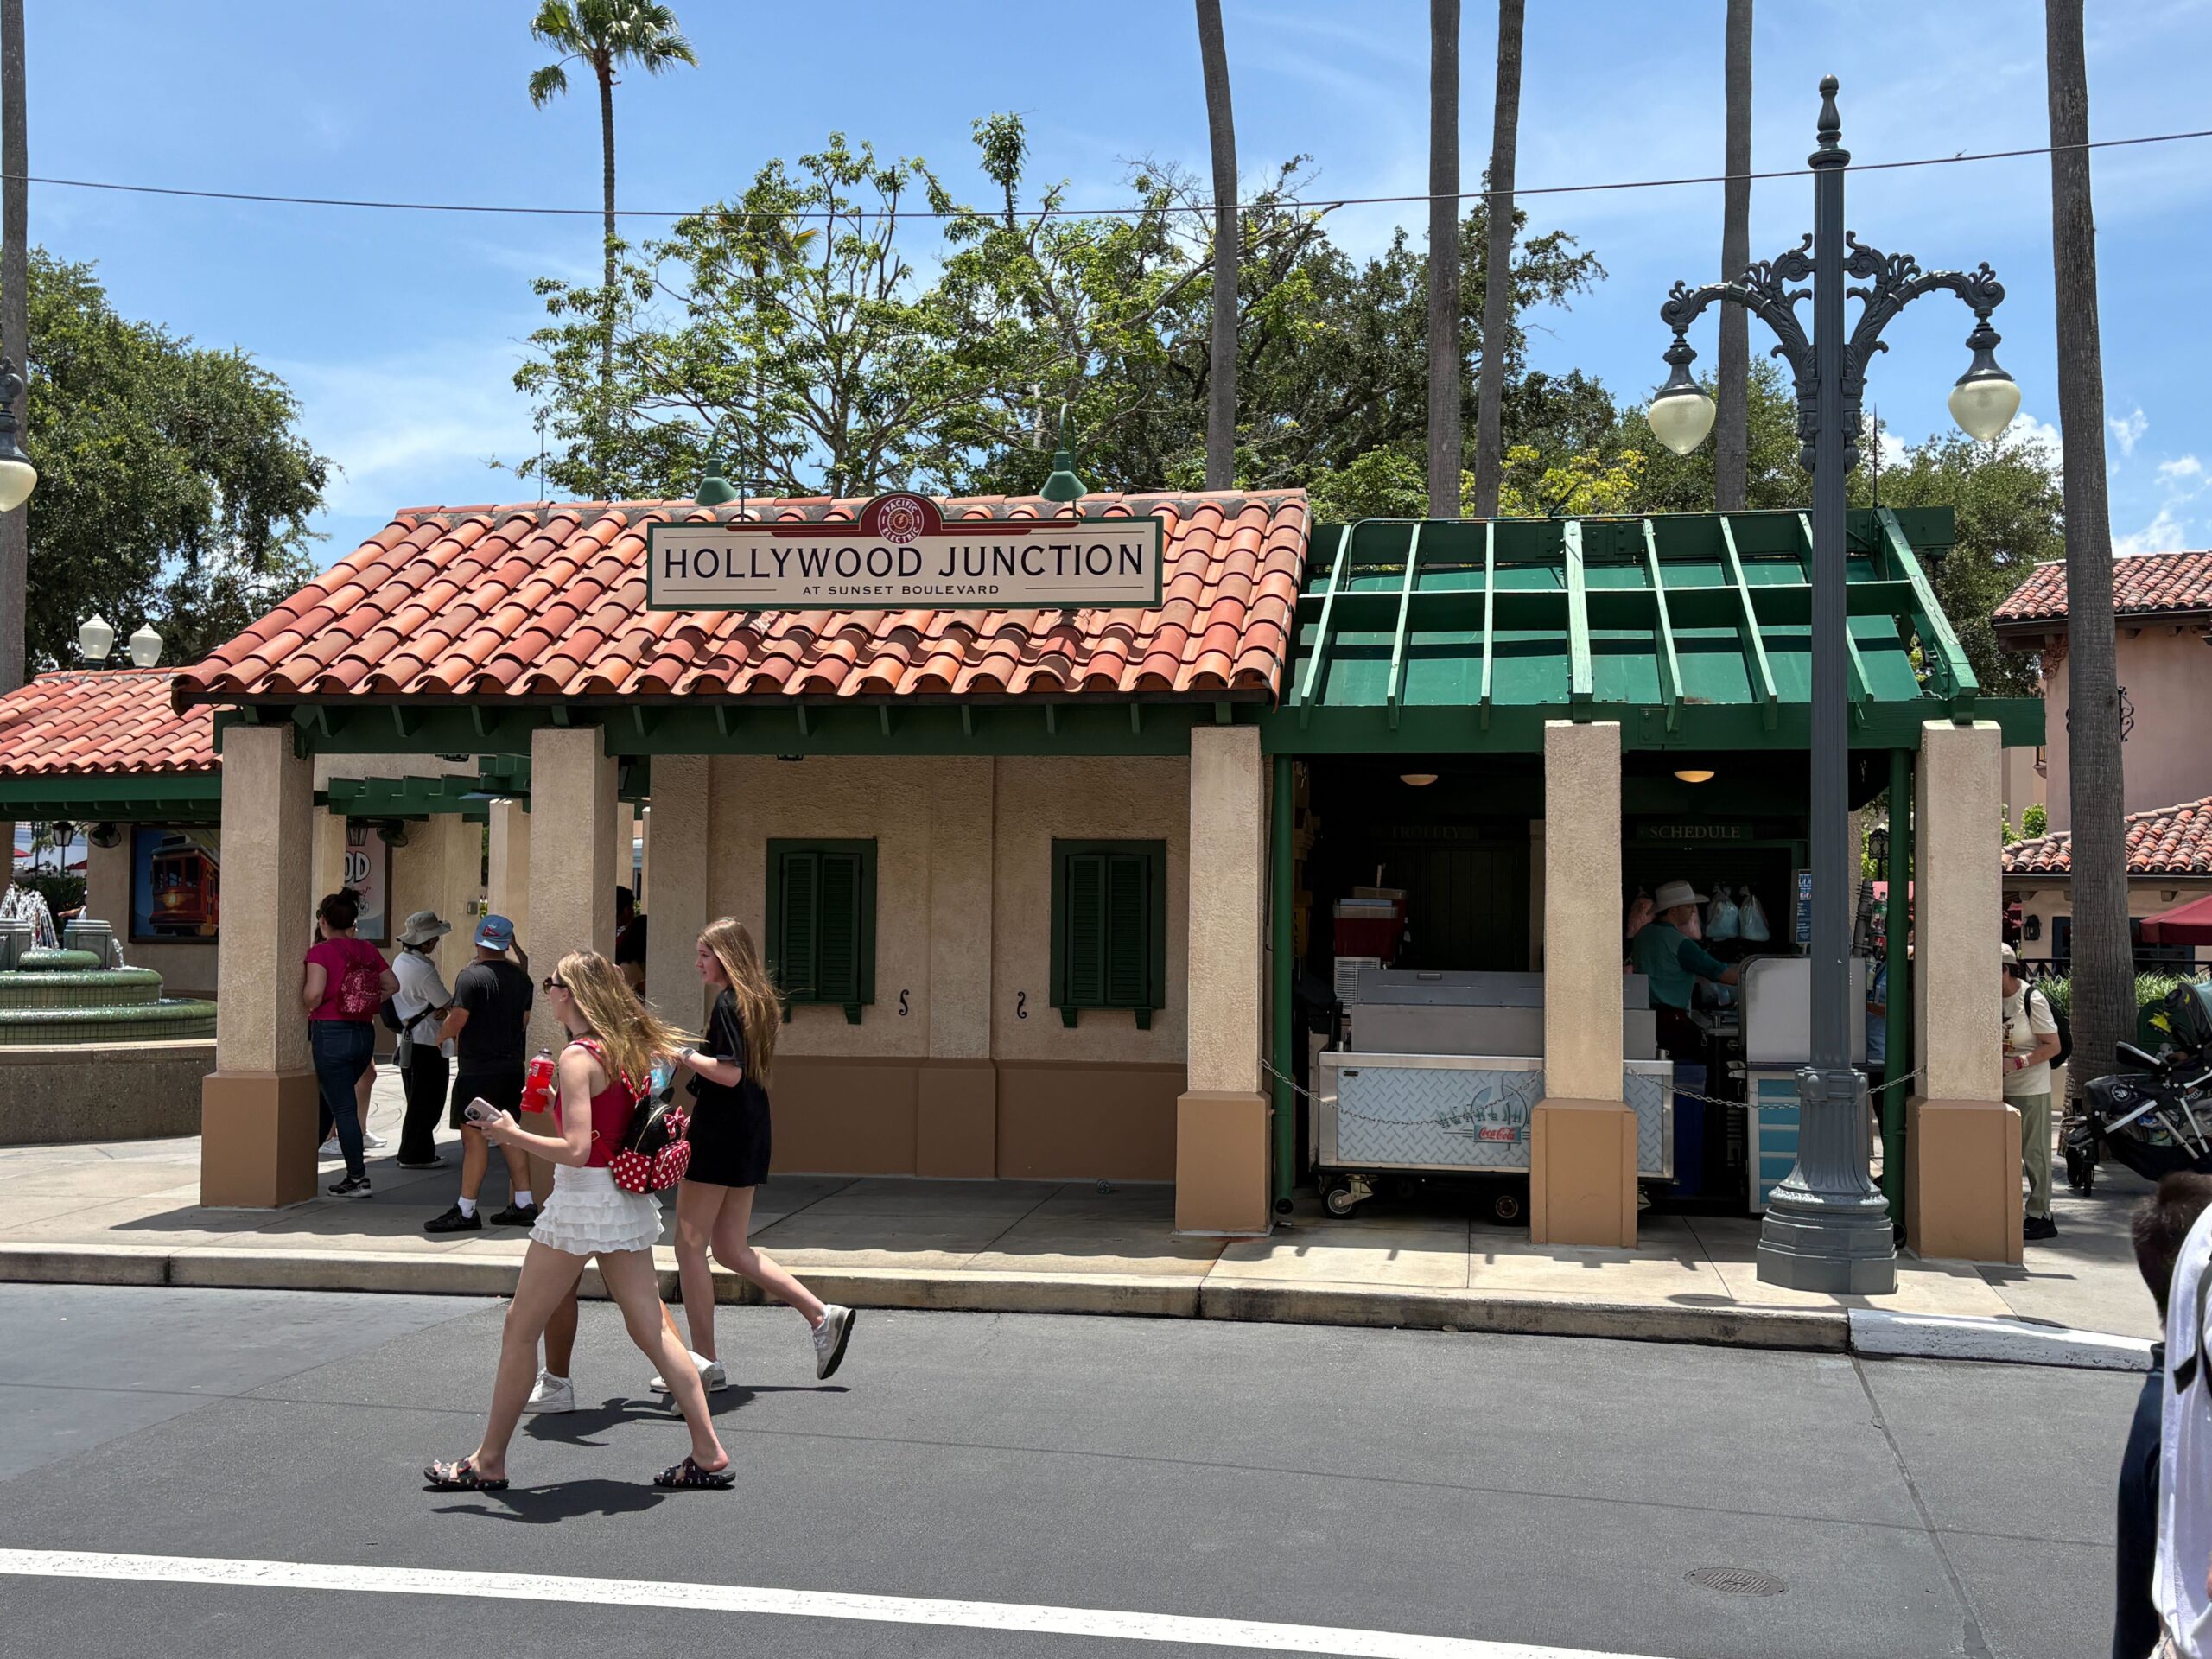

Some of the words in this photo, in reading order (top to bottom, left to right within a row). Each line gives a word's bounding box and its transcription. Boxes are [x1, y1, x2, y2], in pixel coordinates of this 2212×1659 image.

[885, 499, 918, 513] PACIFIC
[881, 527, 920, 543] ELECTRIC
[664, 547, 922, 578] HOLLYWOOD
[938, 544, 1142, 576] JUNCTION
[802, 586, 821, 595] AT
[828, 585, 893, 595] SUNSET
[901, 585, 999, 594] BOULEVARD
[1649, 825, 1741, 839] SCHEDULE
